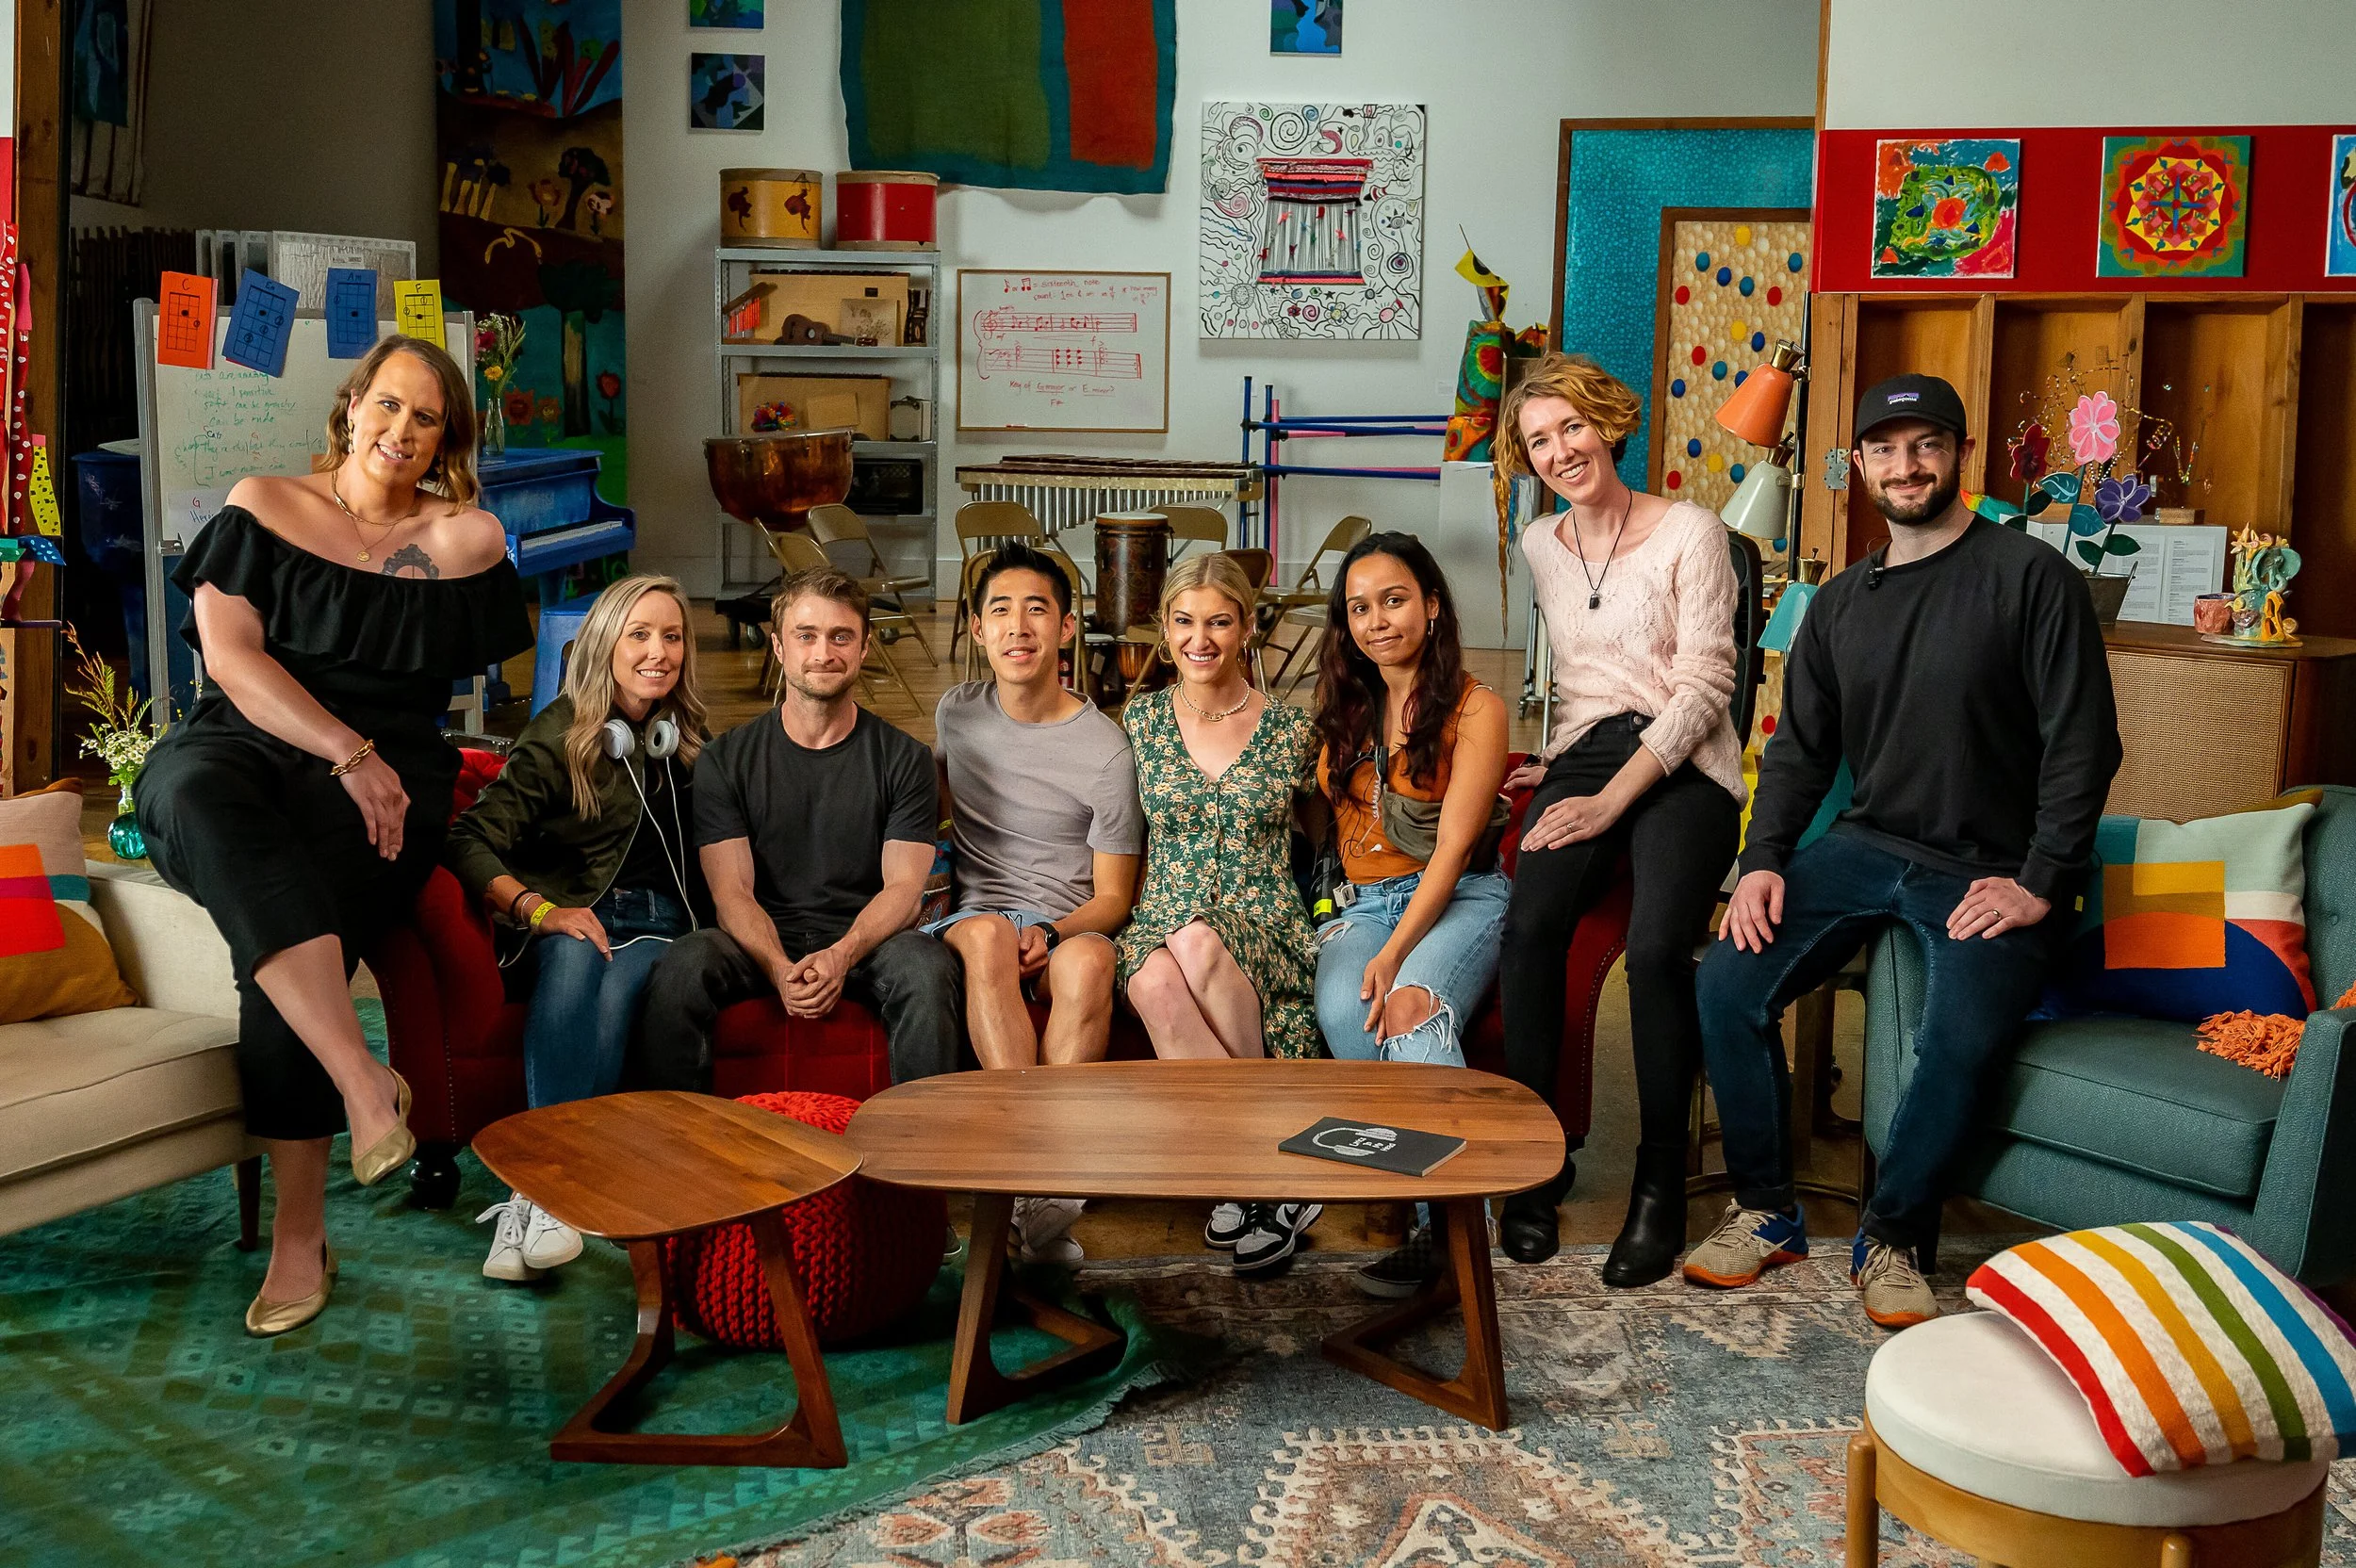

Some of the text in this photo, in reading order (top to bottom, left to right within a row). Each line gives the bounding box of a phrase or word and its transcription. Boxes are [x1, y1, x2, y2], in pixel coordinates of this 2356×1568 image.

[347, 271, 362, 282] Am
[182, 279, 190, 290] C
[415, 283, 422, 293] F
[192, 497, 201, 508] G
